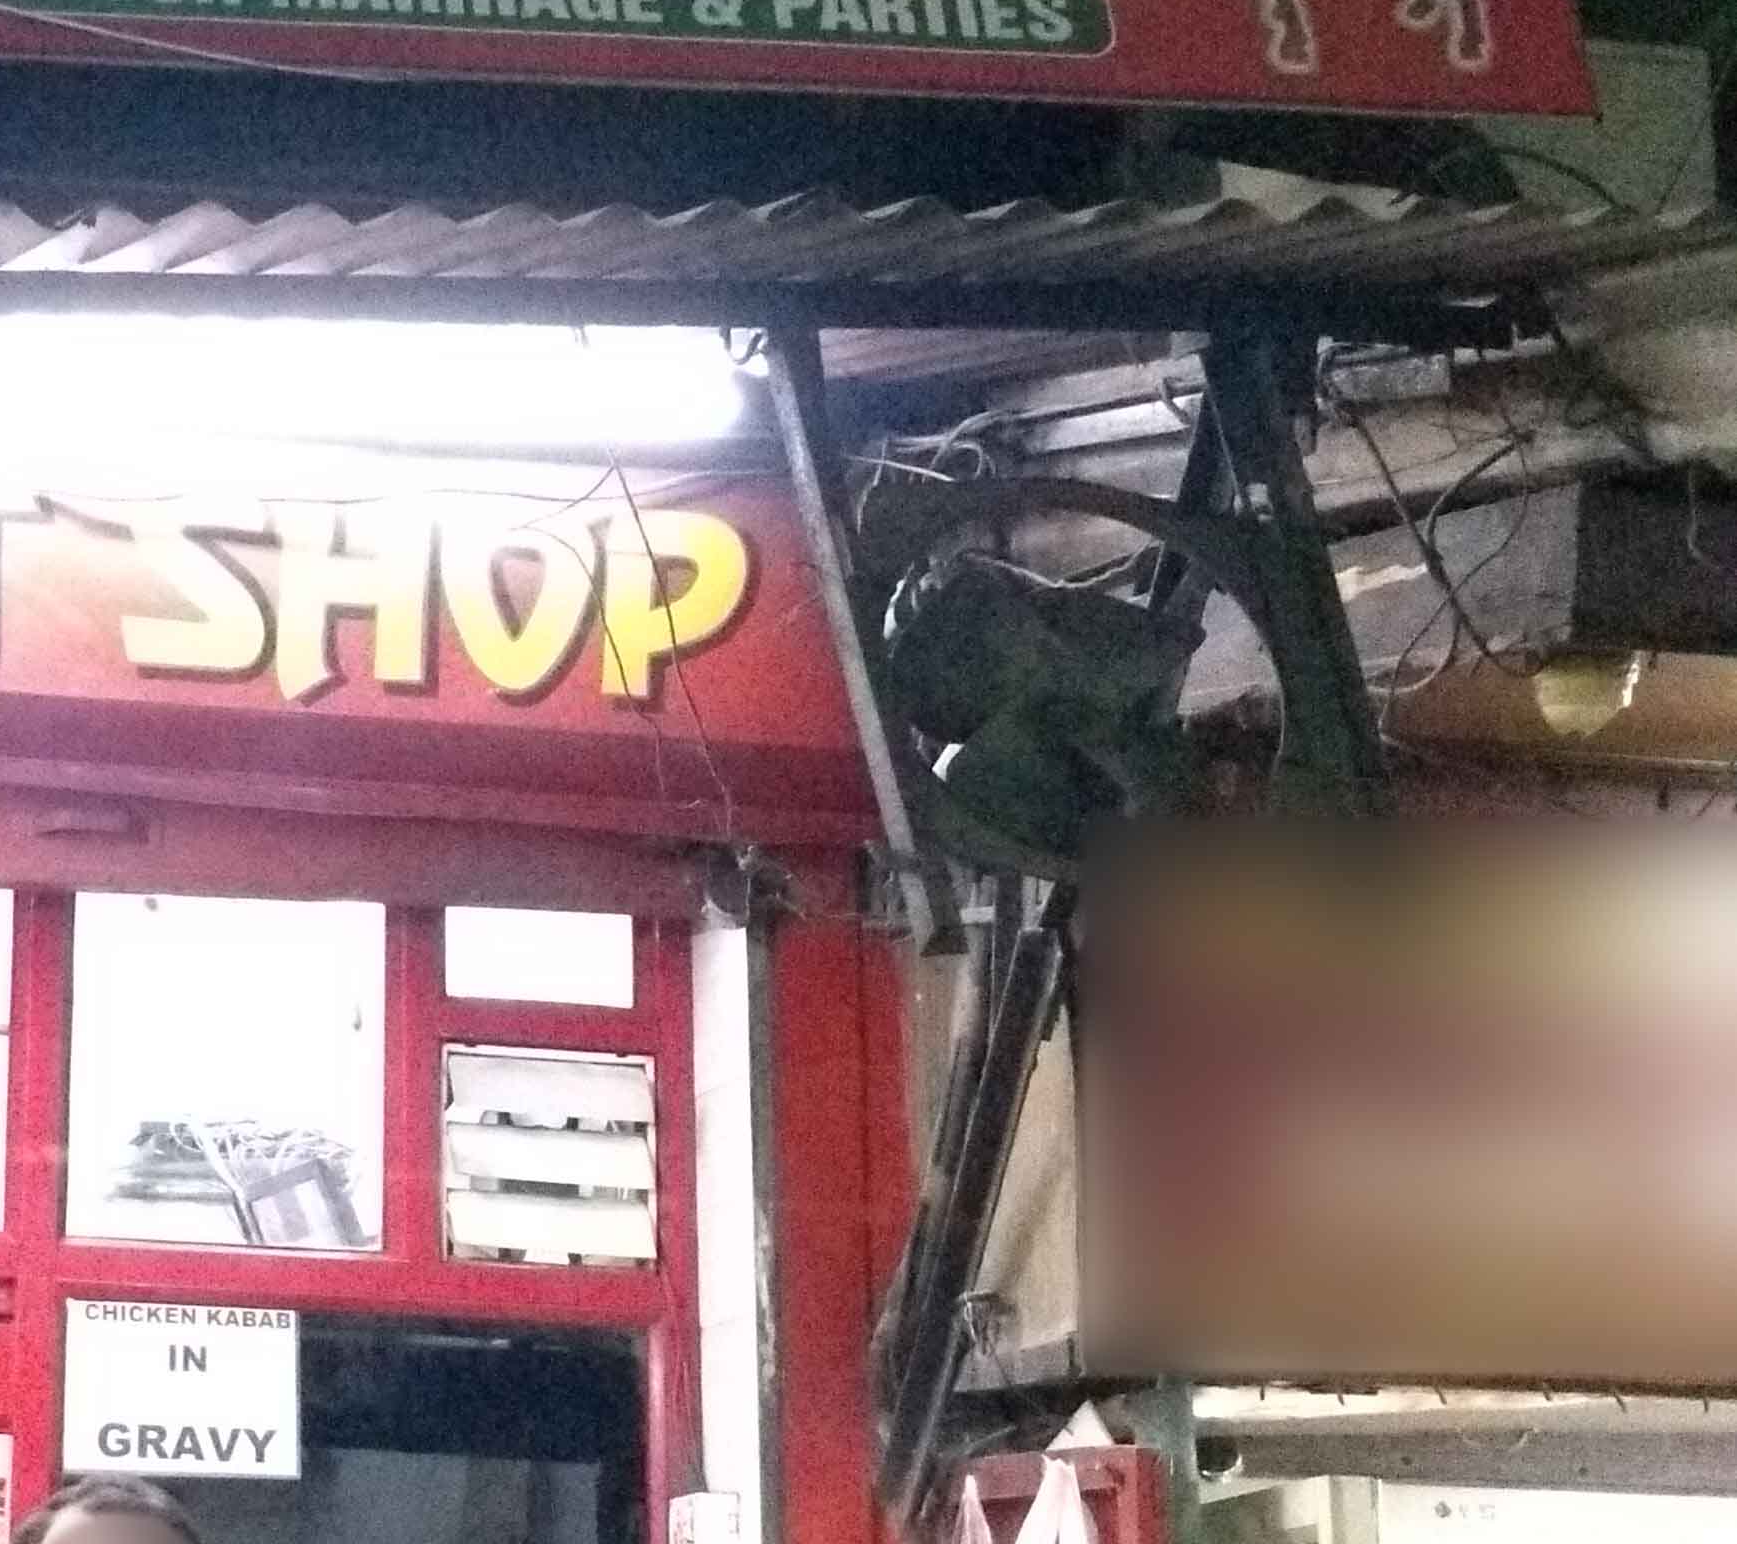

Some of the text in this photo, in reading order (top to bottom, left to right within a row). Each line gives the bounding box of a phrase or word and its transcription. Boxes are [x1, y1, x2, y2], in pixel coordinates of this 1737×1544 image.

[37, 496, 755, 706] SHOP
[85, 1303, 292, 1330] CHICKEN KABAB
[168, 1343, 208, 1373] IN
[97, 1422, 278, 1464] GRAVY
